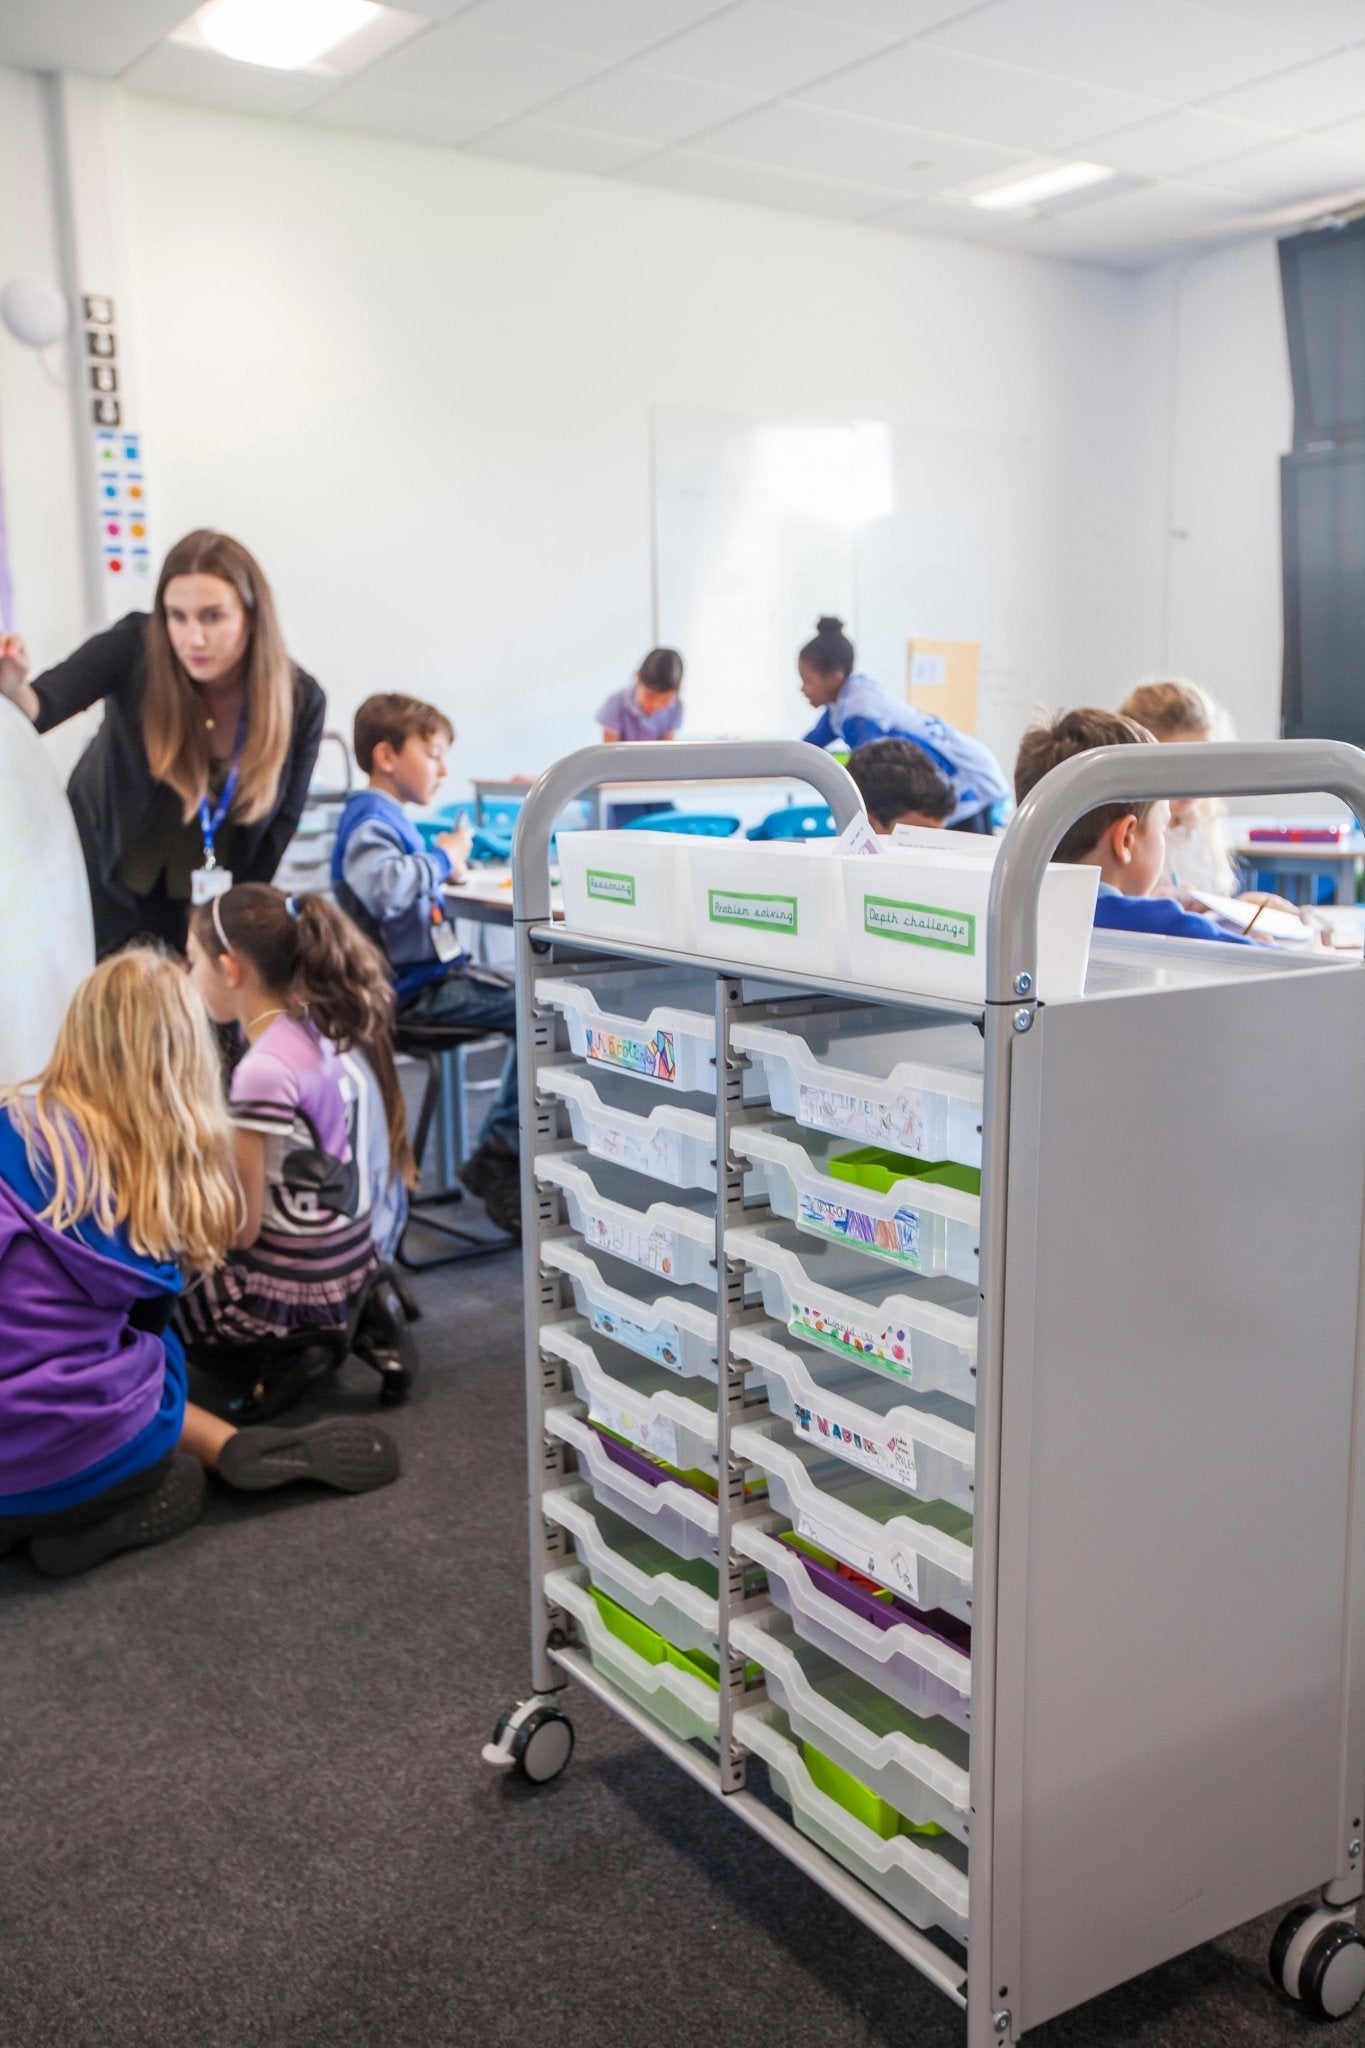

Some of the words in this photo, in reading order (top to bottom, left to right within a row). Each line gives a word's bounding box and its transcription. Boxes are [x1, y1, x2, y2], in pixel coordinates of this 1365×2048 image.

[590, 877, 632, 897] Reasoning
[714, 902, 751, 917] Problem
[753, 906, 793, 925] solving
[869, 907, 899, 927] Depth
[903, 914, 966, 939] challenge
